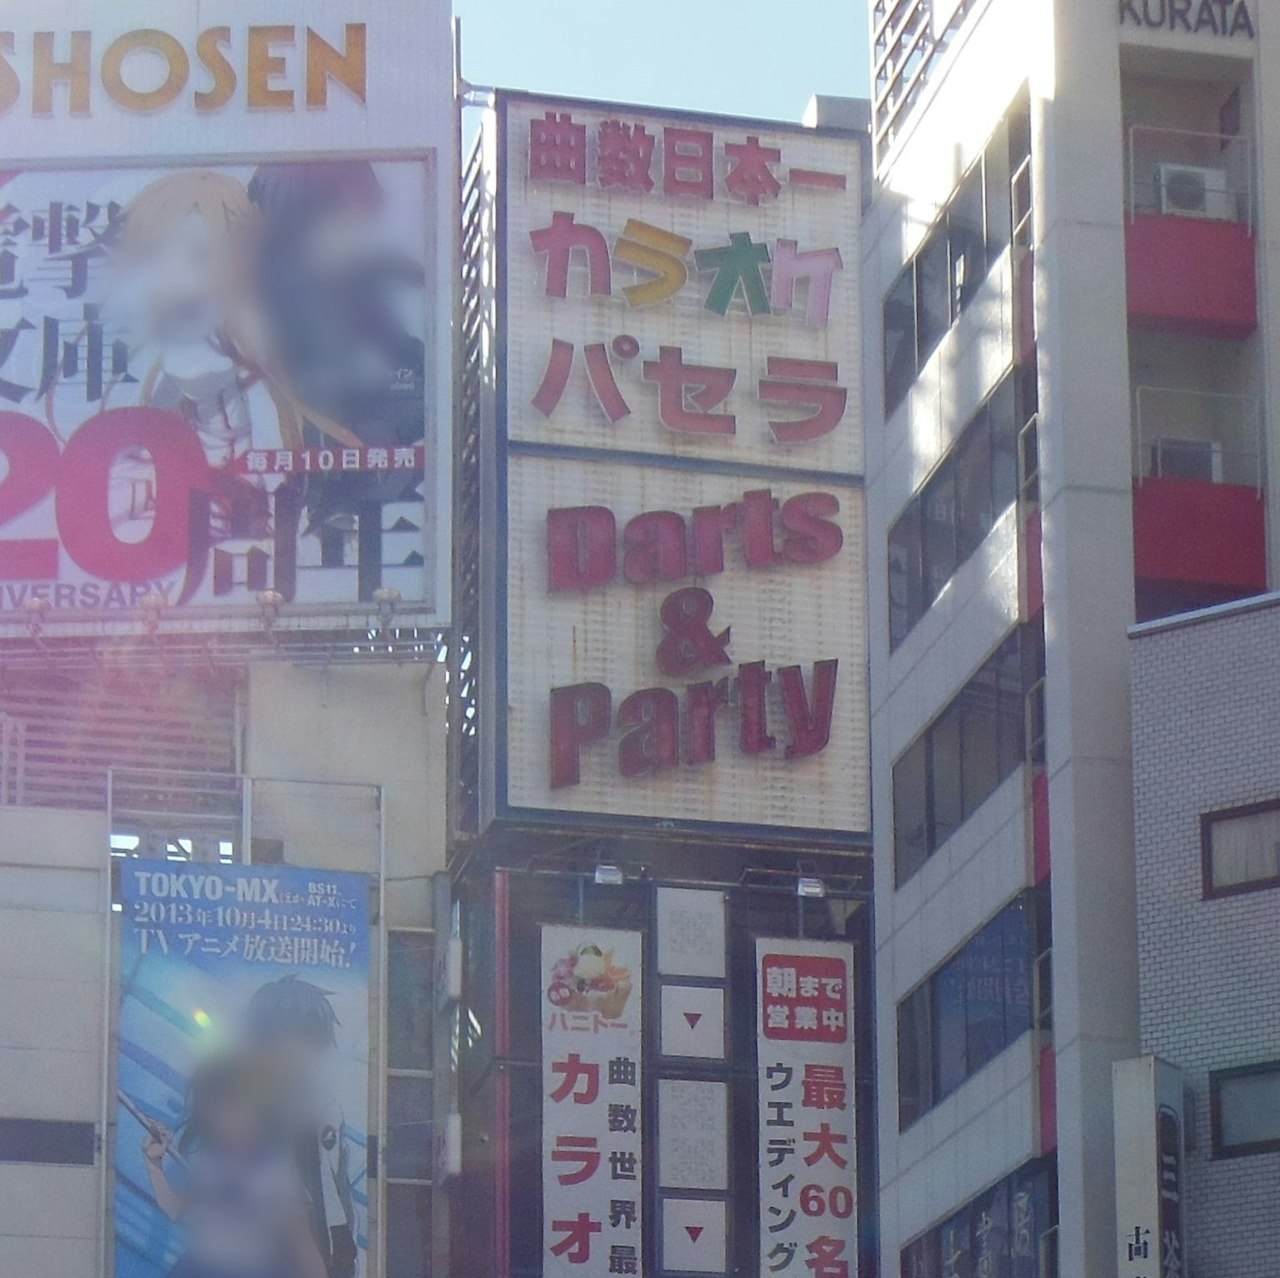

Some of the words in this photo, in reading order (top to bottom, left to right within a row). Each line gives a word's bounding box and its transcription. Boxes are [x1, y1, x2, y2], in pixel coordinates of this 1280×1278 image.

[528, 112, 847, 206] 曲数日本一
[528, 210, 844, 330] カラオケ
[530, 334, 848, 443] パセラ
[245, 447, 417, 472] 毎月10日発売
[547, 488, 844, 593] Darts
[655, 587, 732, 678] &
[550, 658, 839, 790] Party
[134, 871, 280, 904] TOKYO-MX
[548, 1013, 628, 1034] ハニトー
[766, 966, 843, 1000] 朝まで
[767, 1006, 844, 1032] 営業中
